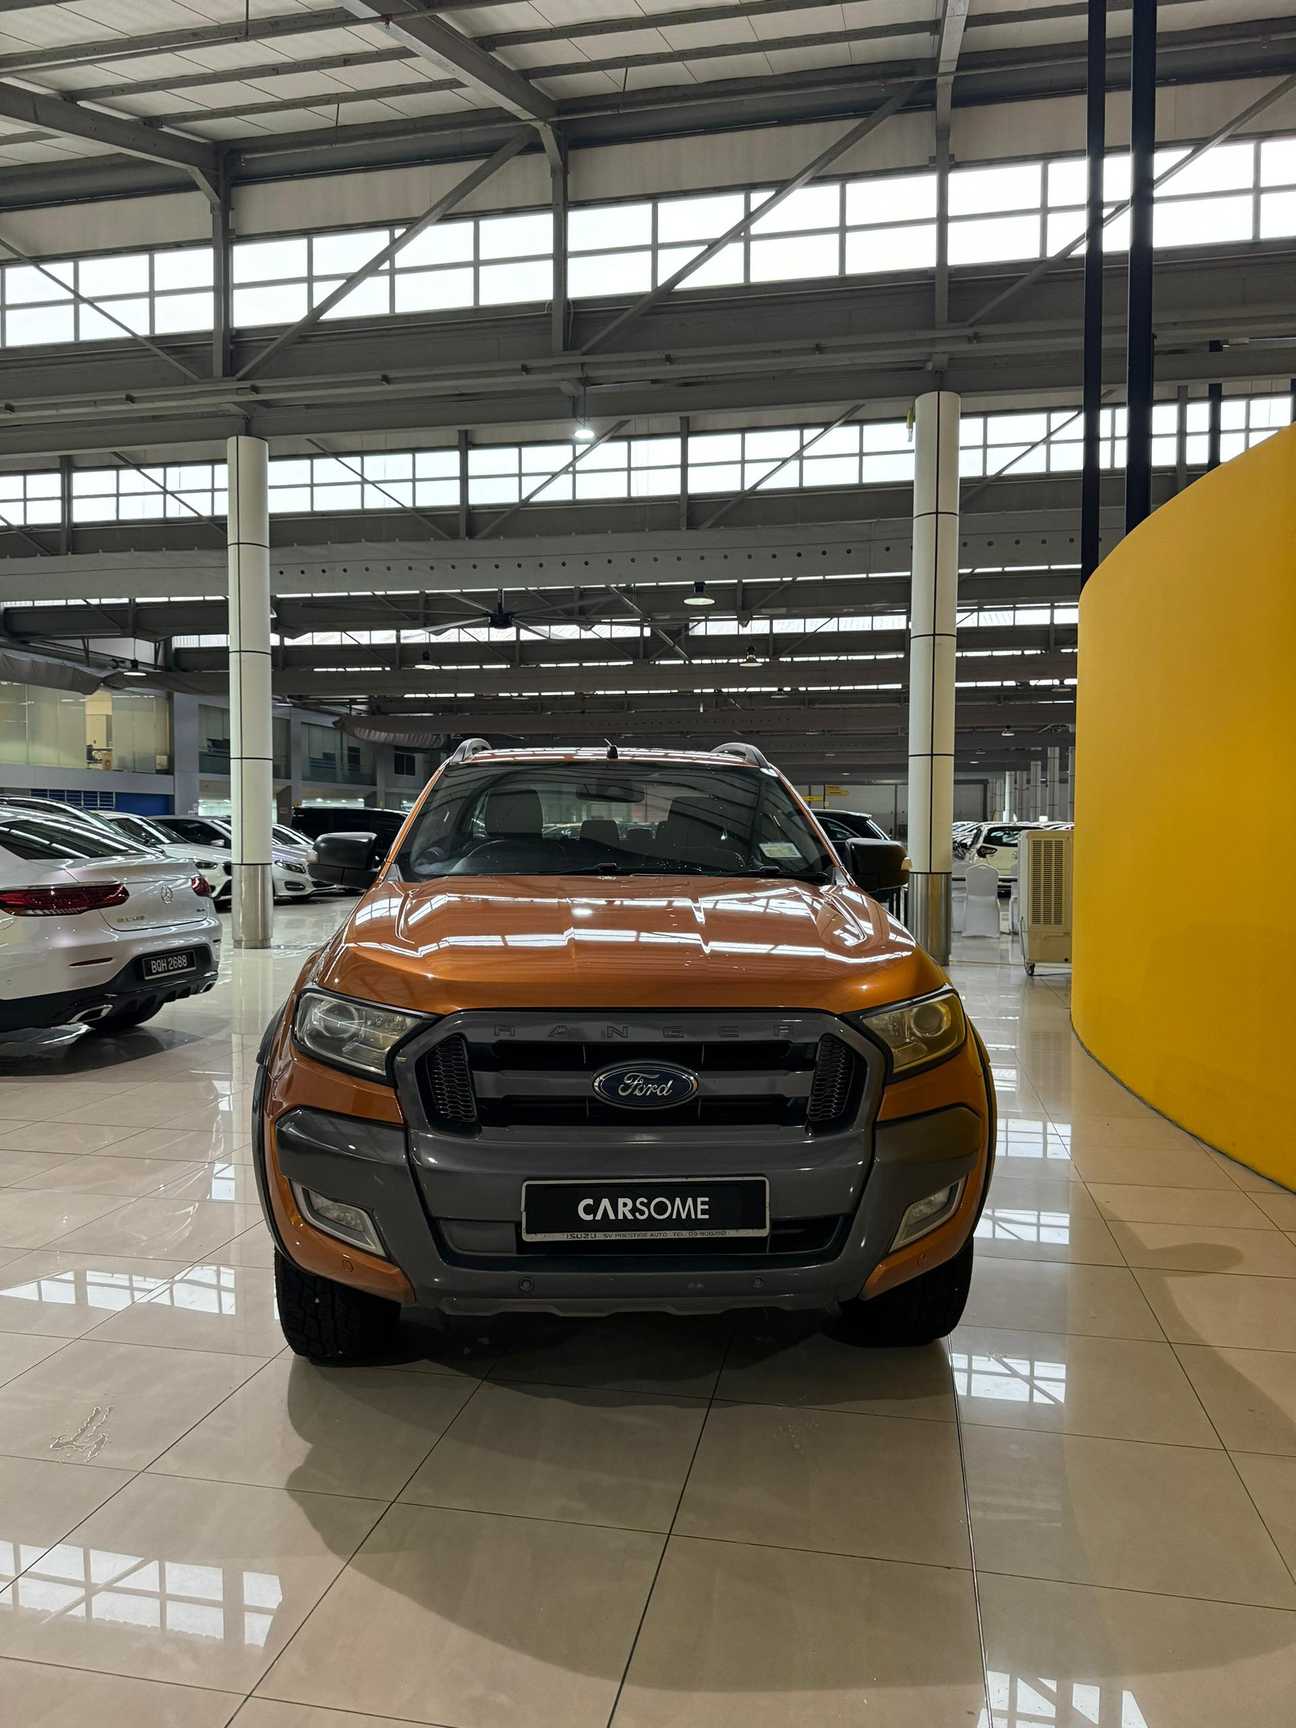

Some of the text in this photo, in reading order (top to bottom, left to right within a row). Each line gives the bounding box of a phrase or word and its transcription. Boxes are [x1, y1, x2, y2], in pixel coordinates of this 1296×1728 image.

[494, 1024, 793, 1039] RANGER
[618, 1072, 673, 1097] Ford
[578, 1197, 709, 1220] CARSOME
